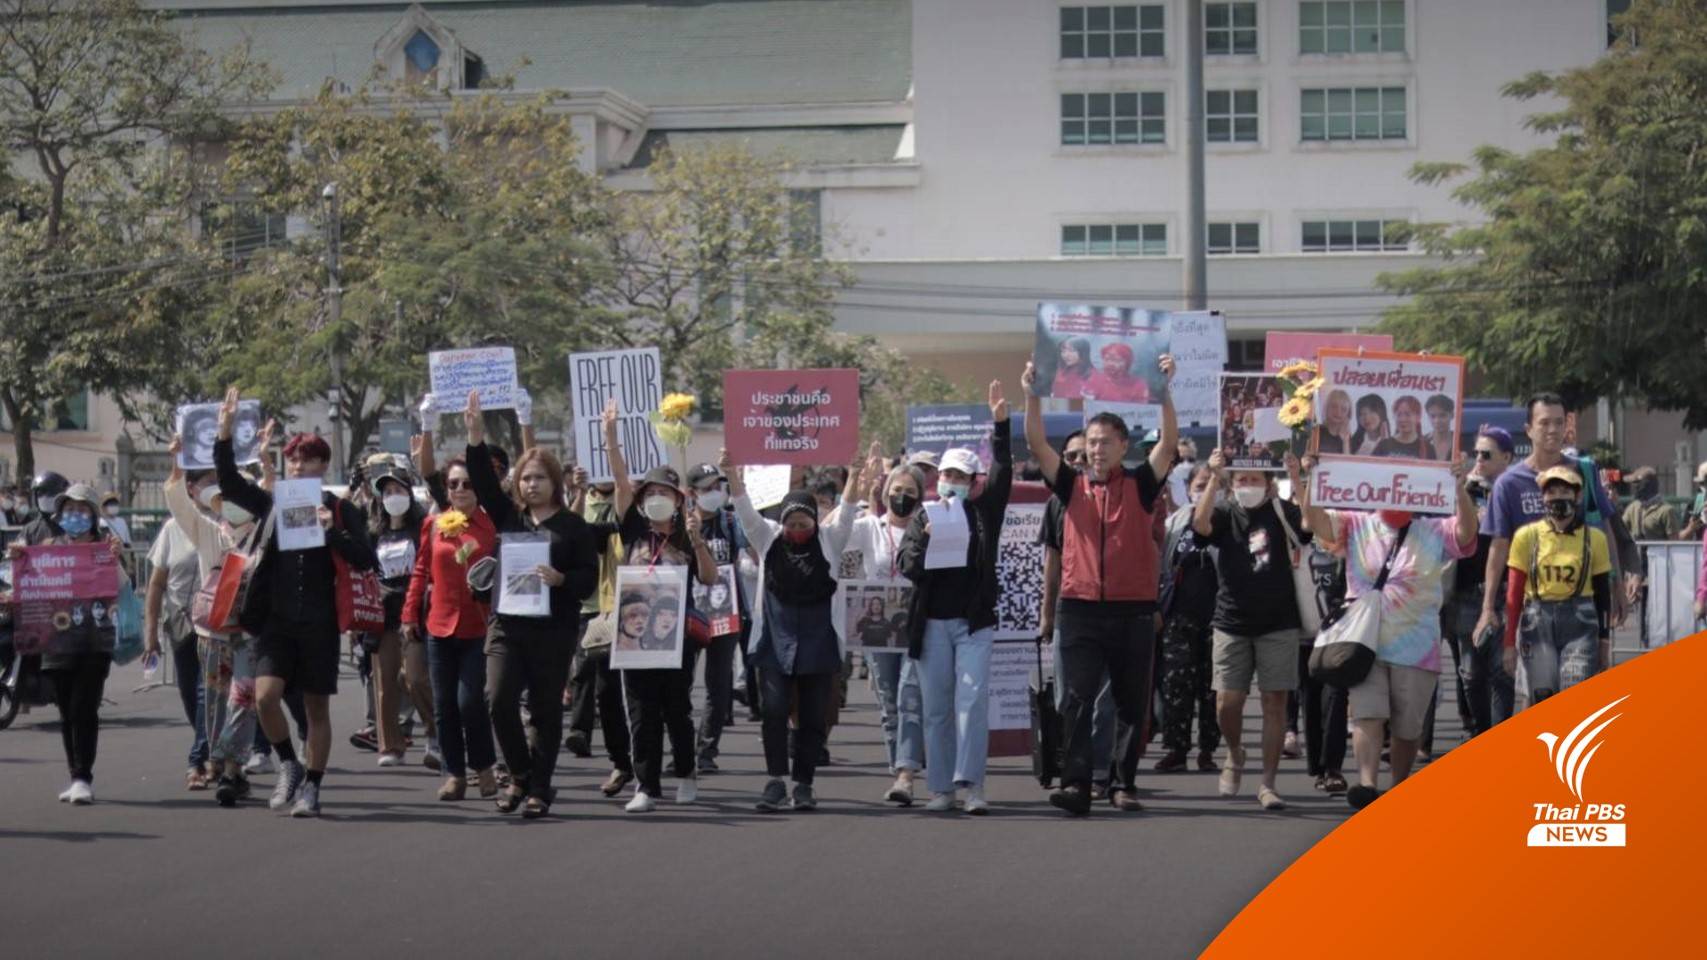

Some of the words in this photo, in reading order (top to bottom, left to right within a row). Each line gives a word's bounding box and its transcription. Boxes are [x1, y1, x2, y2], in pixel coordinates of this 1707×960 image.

[621, 353, 659, 413] OUR
[751, 390, 831, 405] ประชาชนคือ
[743, 408, 840, 427] เจ้าของประเทศ
[588, 416, 661, 478] FRNDS
[764, 431, 819, 450] ที่แท้จริง
[1317, 470, 1354, 502] Free
[1357, 482, 1392, 503] Our
[1391, 473, 1449, 508] Friends.
[1543, 564, 1575, 583] 112
[713, 623, 730, 635] 112
